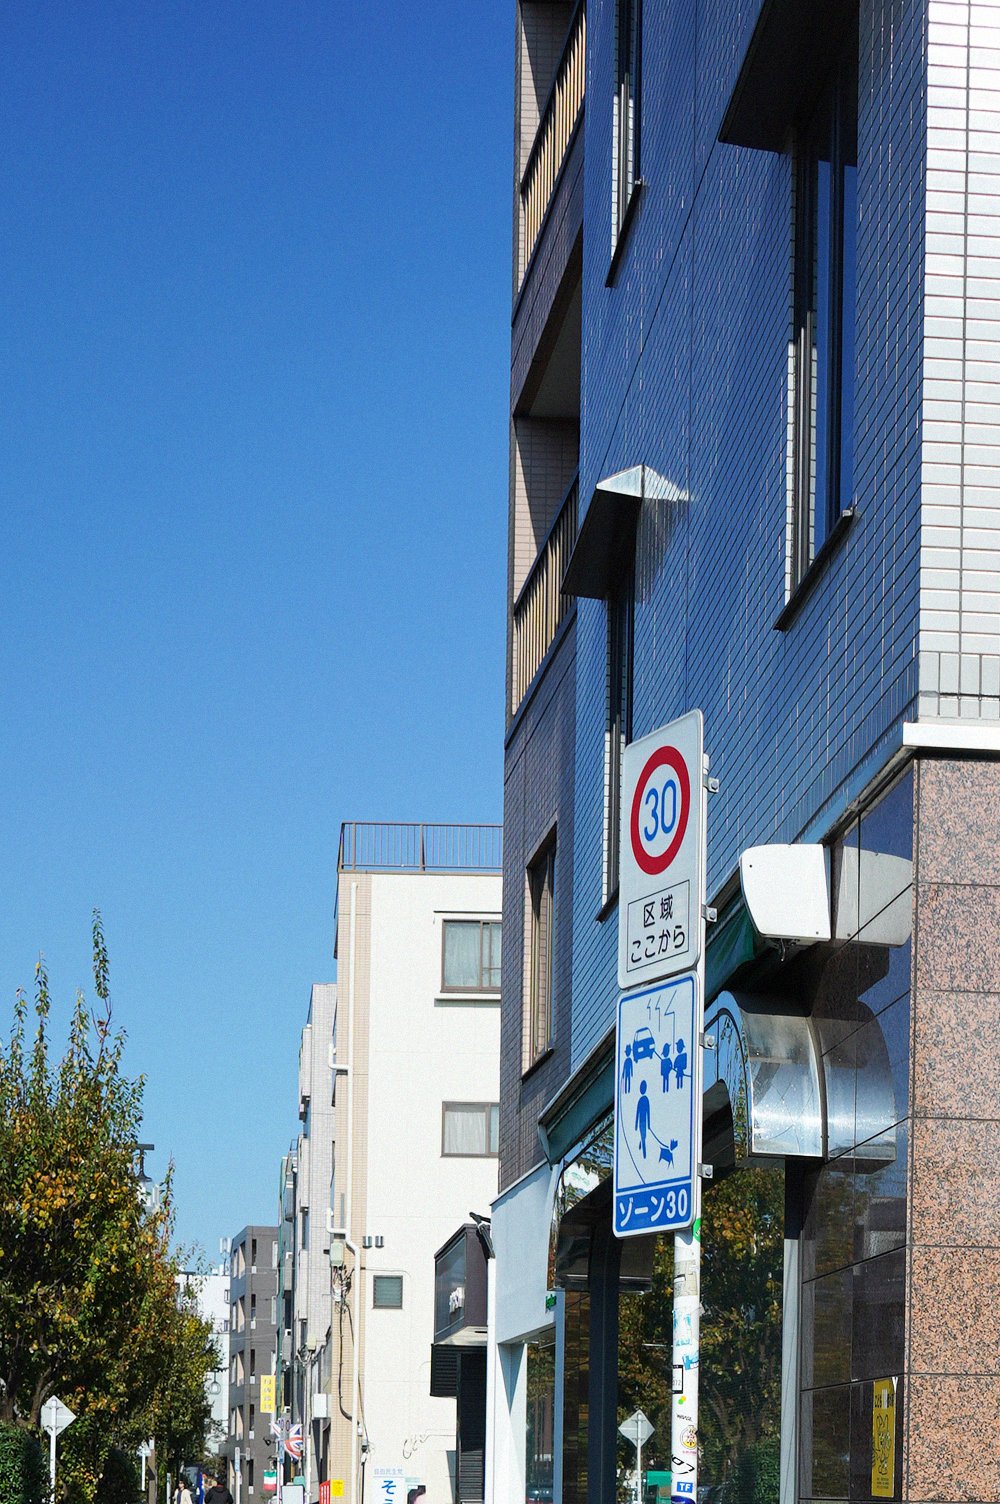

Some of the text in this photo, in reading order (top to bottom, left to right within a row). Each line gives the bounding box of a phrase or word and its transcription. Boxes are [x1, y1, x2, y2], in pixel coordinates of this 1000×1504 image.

[643, 778, 677, 842] 30
[643, 894, 673, 928] 区域
[631, 925, 686, 963] ここから
[620, 1188, 688, 1227] ゾーン30
[679, 1483, 691, 1492] TF
